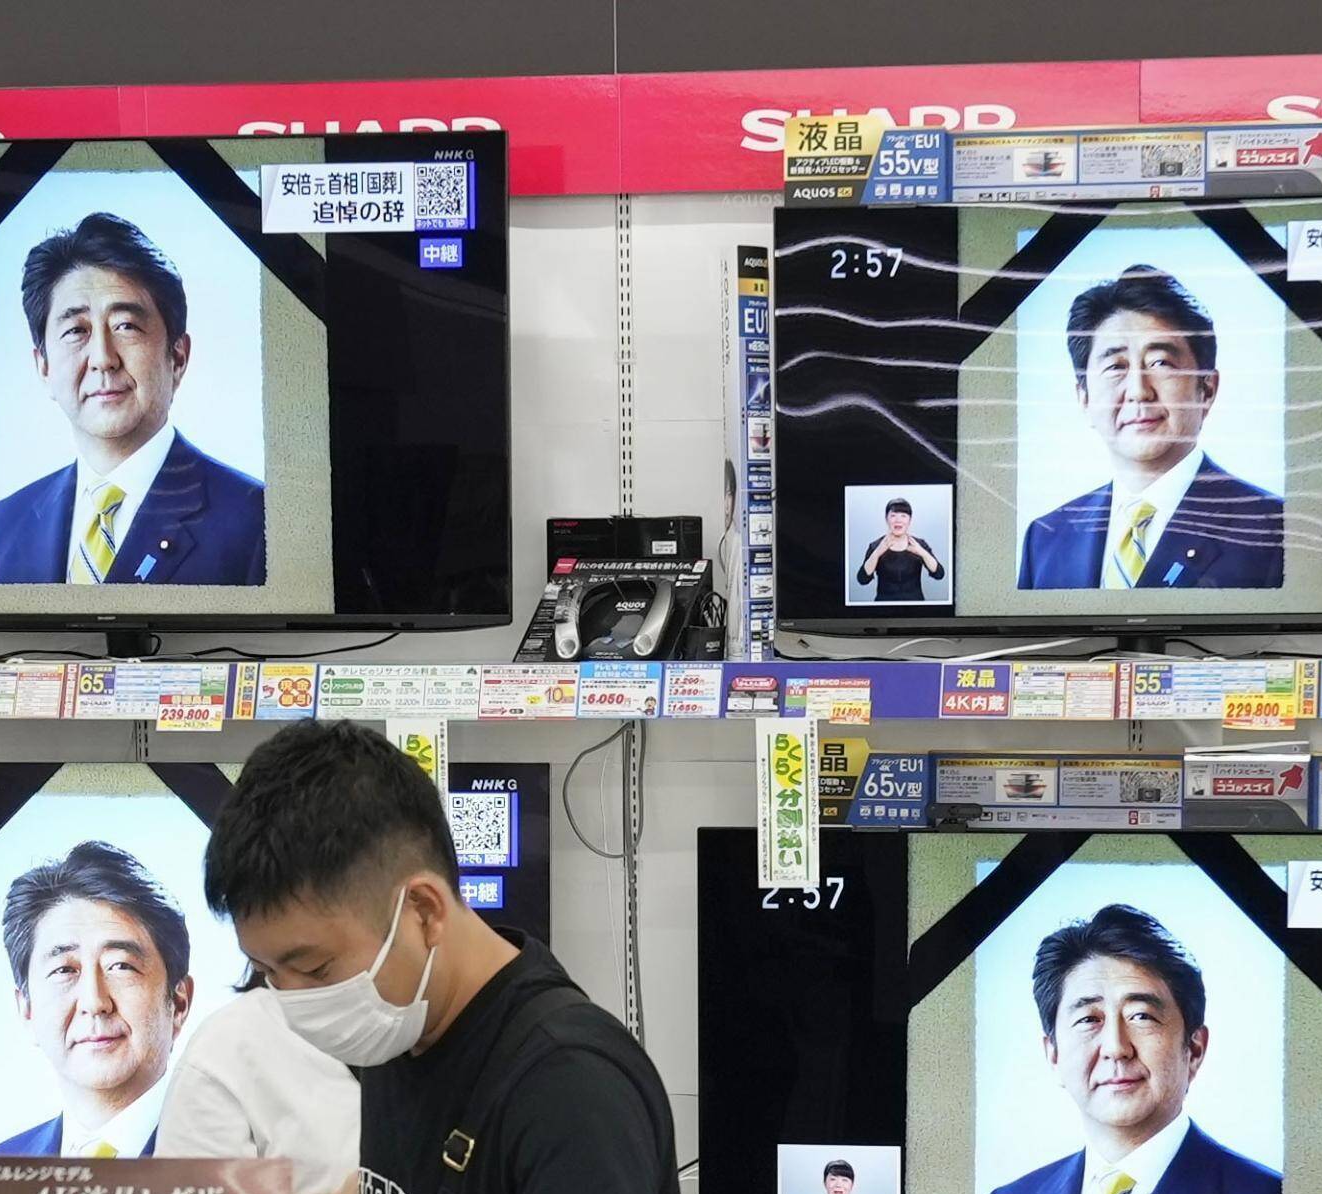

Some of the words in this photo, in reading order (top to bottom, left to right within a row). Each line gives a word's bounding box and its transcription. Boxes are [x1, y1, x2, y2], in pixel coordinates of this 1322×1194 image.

[798, 122, 863, 151] 液晶
[915, 135, 940, 149] EU1
[434, 151, 462, 160] NHK
[879, 150, 940, 176] 55V型
[281, 173, 403, 200] 安倍元首相「国葬」
[793, 188, 835, 199] AQUOS
[313, 201, 404, 224] 追悼の辞
[423, 243, 458, 264] 中継
[831, 249, 903, 279] 2:57
[957, 670, 995, 687] 液晶
[945, 696, 1004, 712] 4K内蔵
[900, 759, 924, 772] EU1
[471, 779, 505, 790] NHK
[507, 779, 518, 790] G
[864, 773, 922, 798] 65V型
[460, 882, 498, 903] 中継
